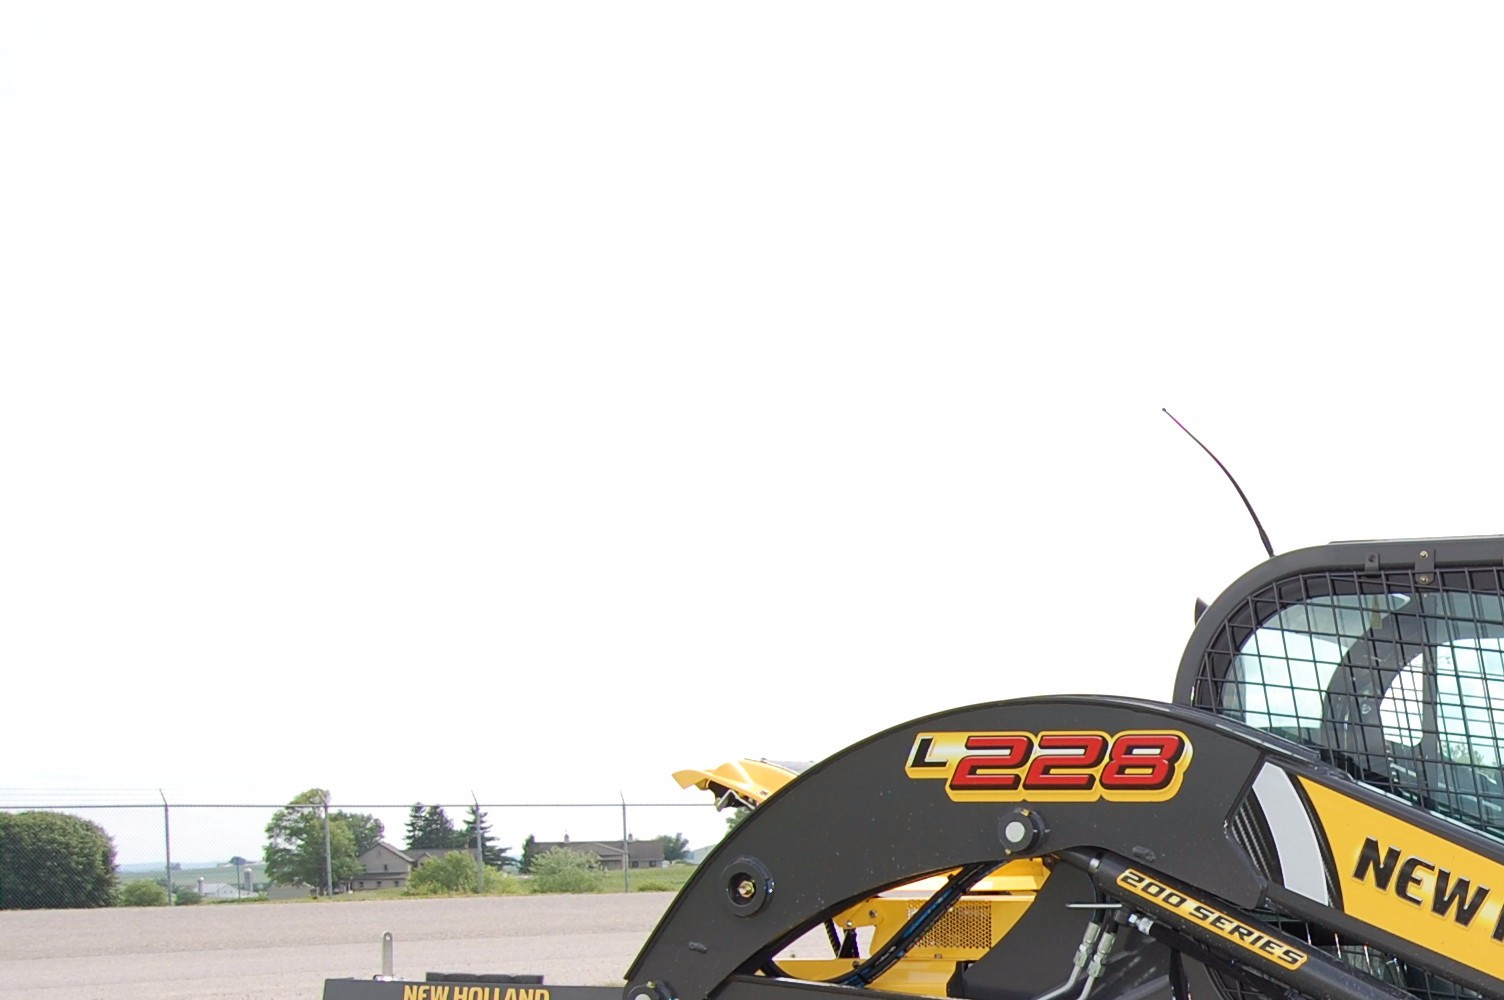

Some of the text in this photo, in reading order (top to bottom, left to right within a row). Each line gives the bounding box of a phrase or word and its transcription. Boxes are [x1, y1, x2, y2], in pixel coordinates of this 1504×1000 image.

[909, 735, 1186, 790] L228
[1120, 870, 1302, 965] 200 SERIES
[1352, 836, 1490, 928] NEW
